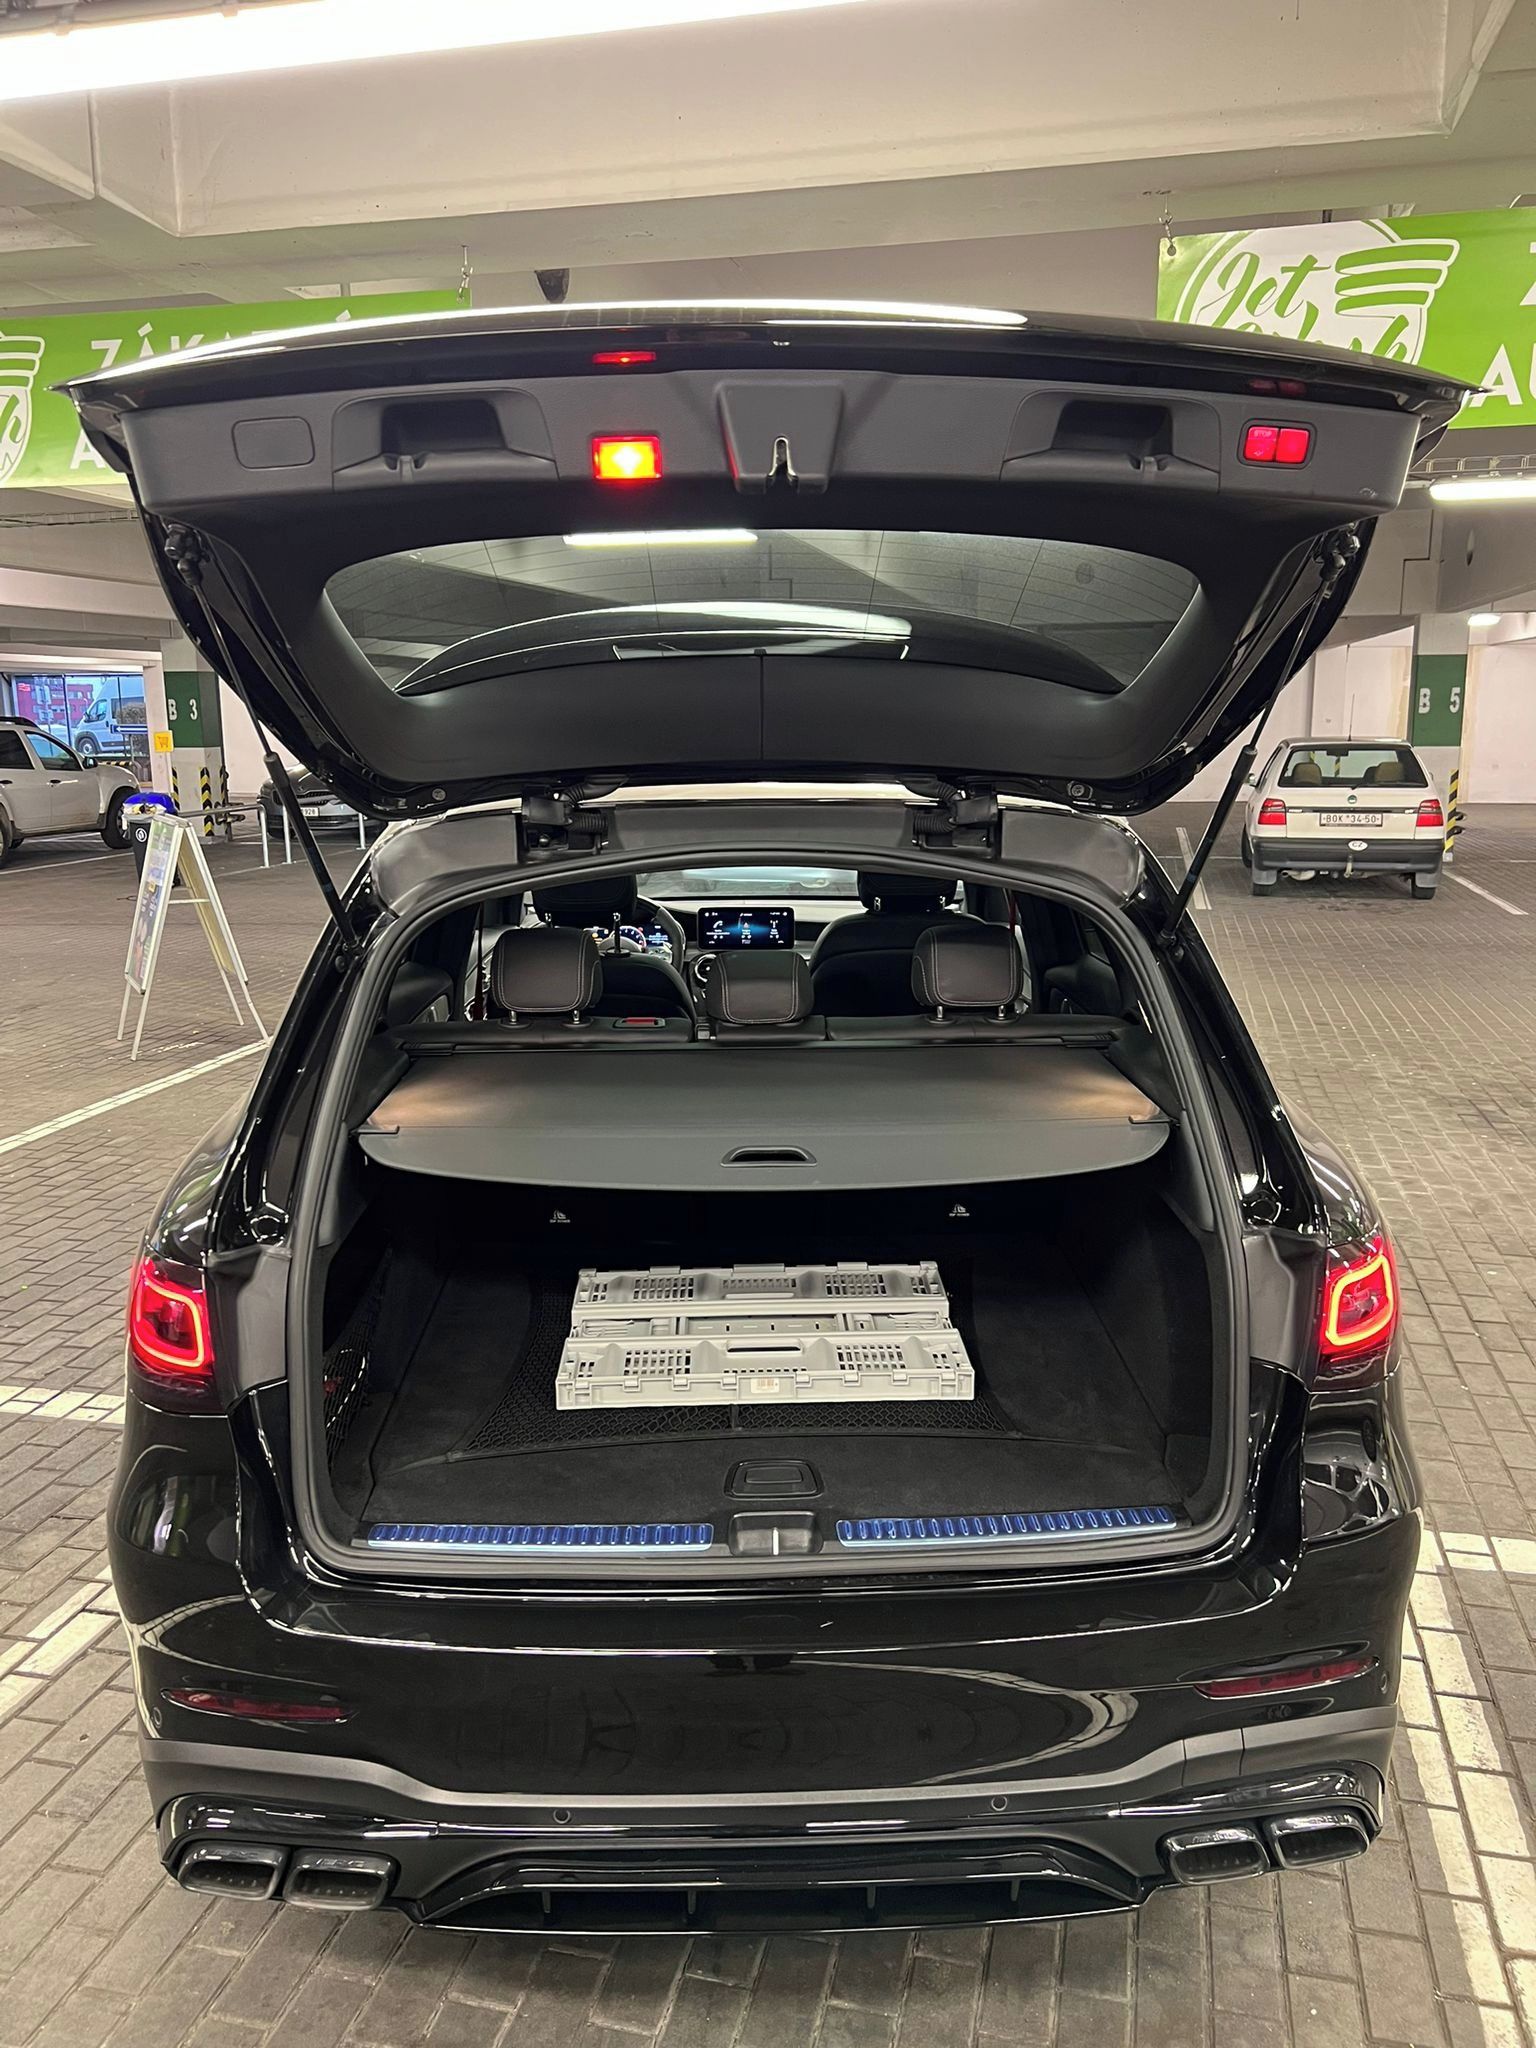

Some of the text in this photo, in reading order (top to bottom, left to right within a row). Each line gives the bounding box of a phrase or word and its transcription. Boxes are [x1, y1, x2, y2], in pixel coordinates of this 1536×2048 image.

[168, 698, 198, 721] B 3
[1418, 686, 1461, 714] B 5
